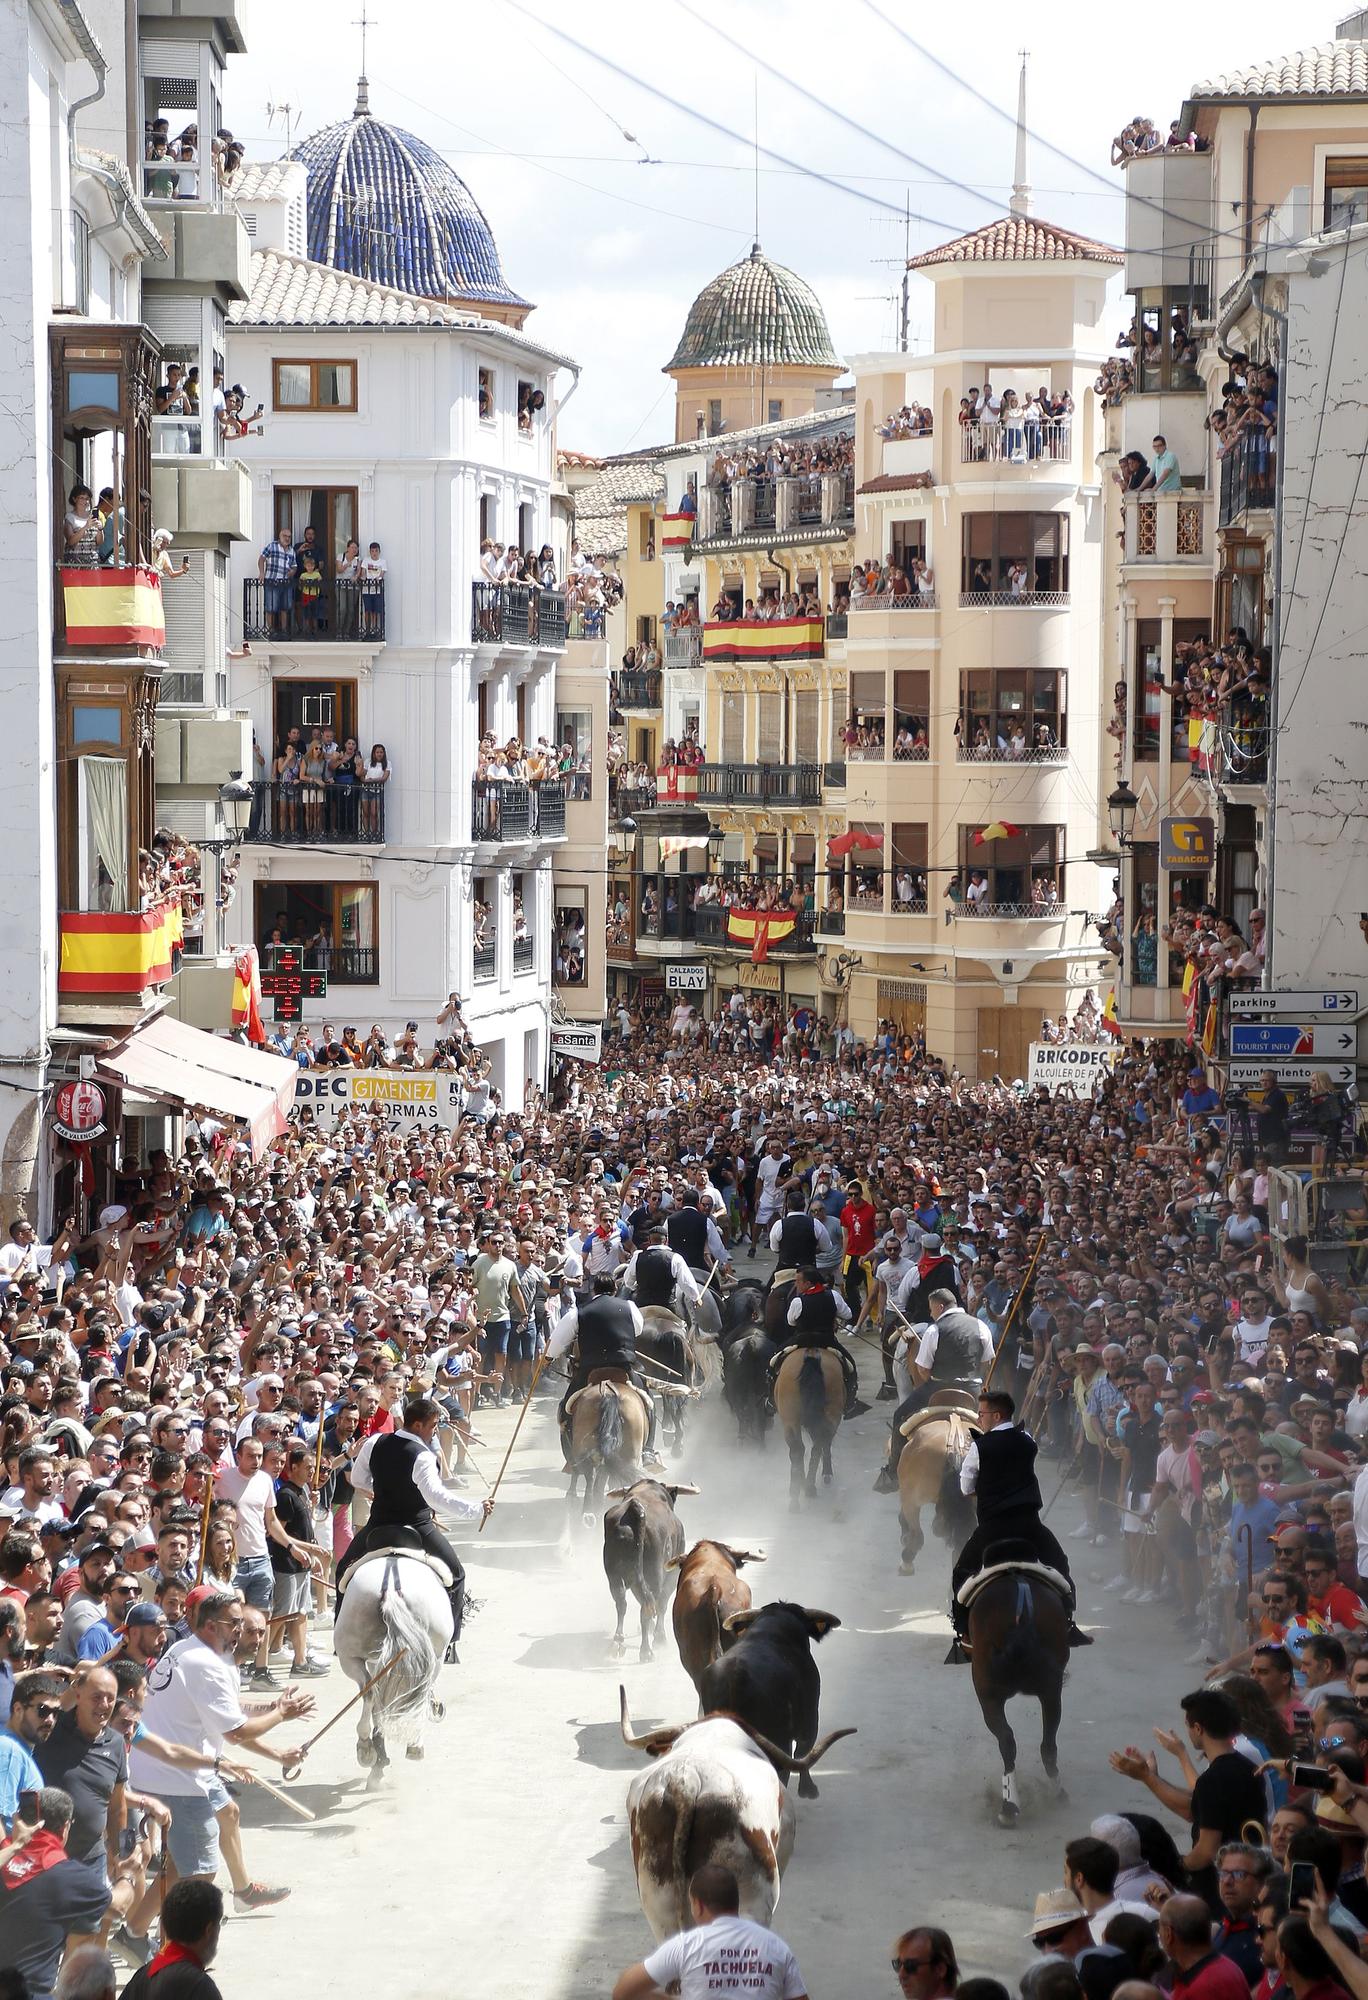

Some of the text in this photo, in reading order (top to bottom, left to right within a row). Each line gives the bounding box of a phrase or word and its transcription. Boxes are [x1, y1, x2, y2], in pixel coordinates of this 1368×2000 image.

[669, 976, 704, 988] BLAY
[1232, 998, 1276, 1008] parking
[1236, 1043, 1290, 1051] TOURIST INFO
[1037, 1050, 1108, 1065] BRICODEC
[1075, 1069, 1086, 1078] DE
[295, 1077, 347, 1097] DEC
[355, 1081, 433, 1100] GIMENEZ
[57, 1126, 98, 1139] BAR VALENCIA
[720, 1949, 758, 1958] PON UN
[703, 1961, 773, 1976] TACHUELA
[709, 1978, 765, 1989] EN TU VIDA
